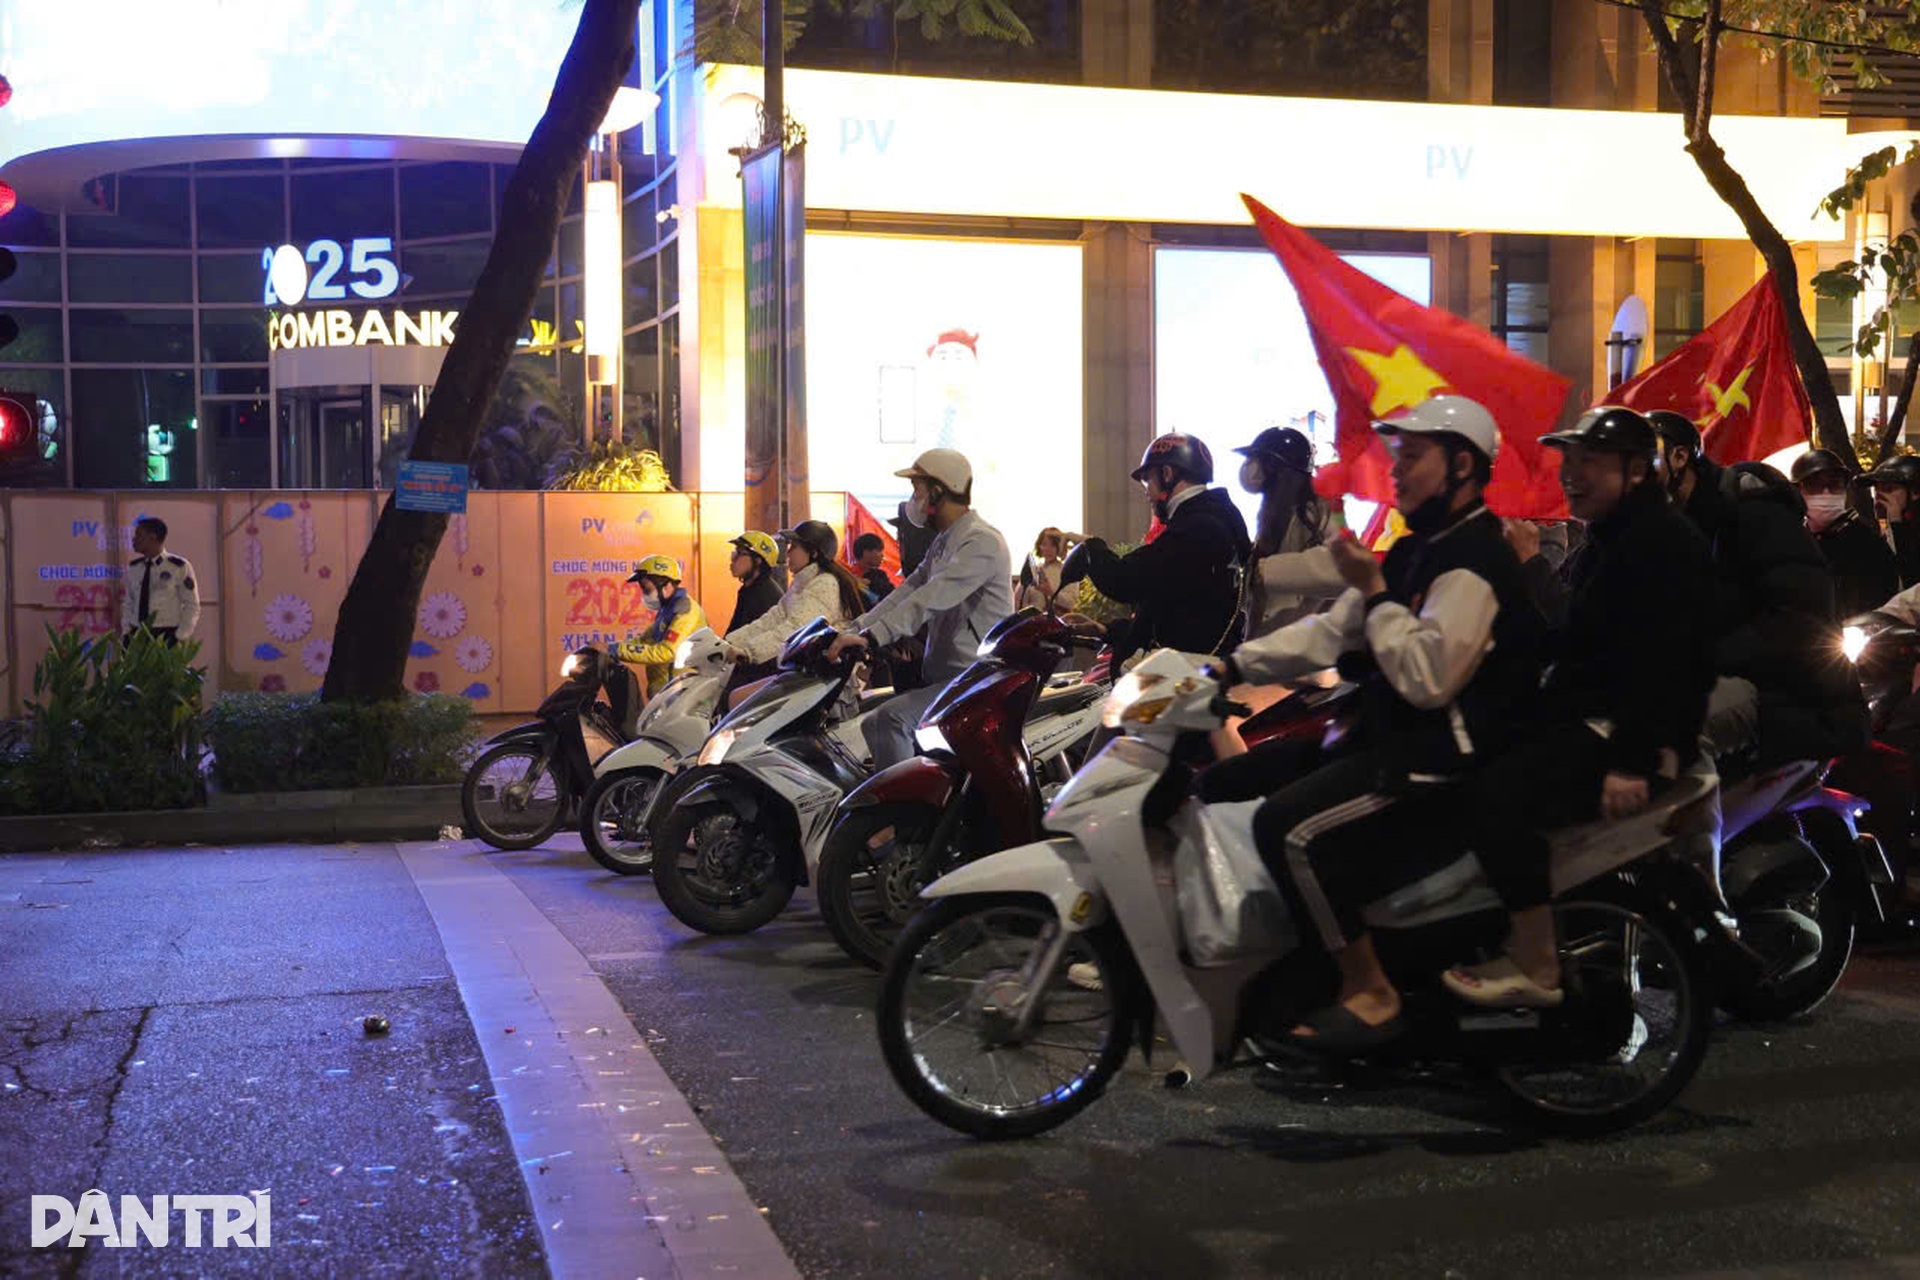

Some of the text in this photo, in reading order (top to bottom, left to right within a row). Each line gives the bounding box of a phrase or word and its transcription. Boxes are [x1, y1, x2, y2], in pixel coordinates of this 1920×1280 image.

[839, 117, 896, 155] PV
[1426, 145, 1474, 180] PV
[269, 309, 459, 351] COMBANK
[71, 520, 98, 538] PV
[581, 518, 606, 533] PV
[565, 577, 657, 626] 202
